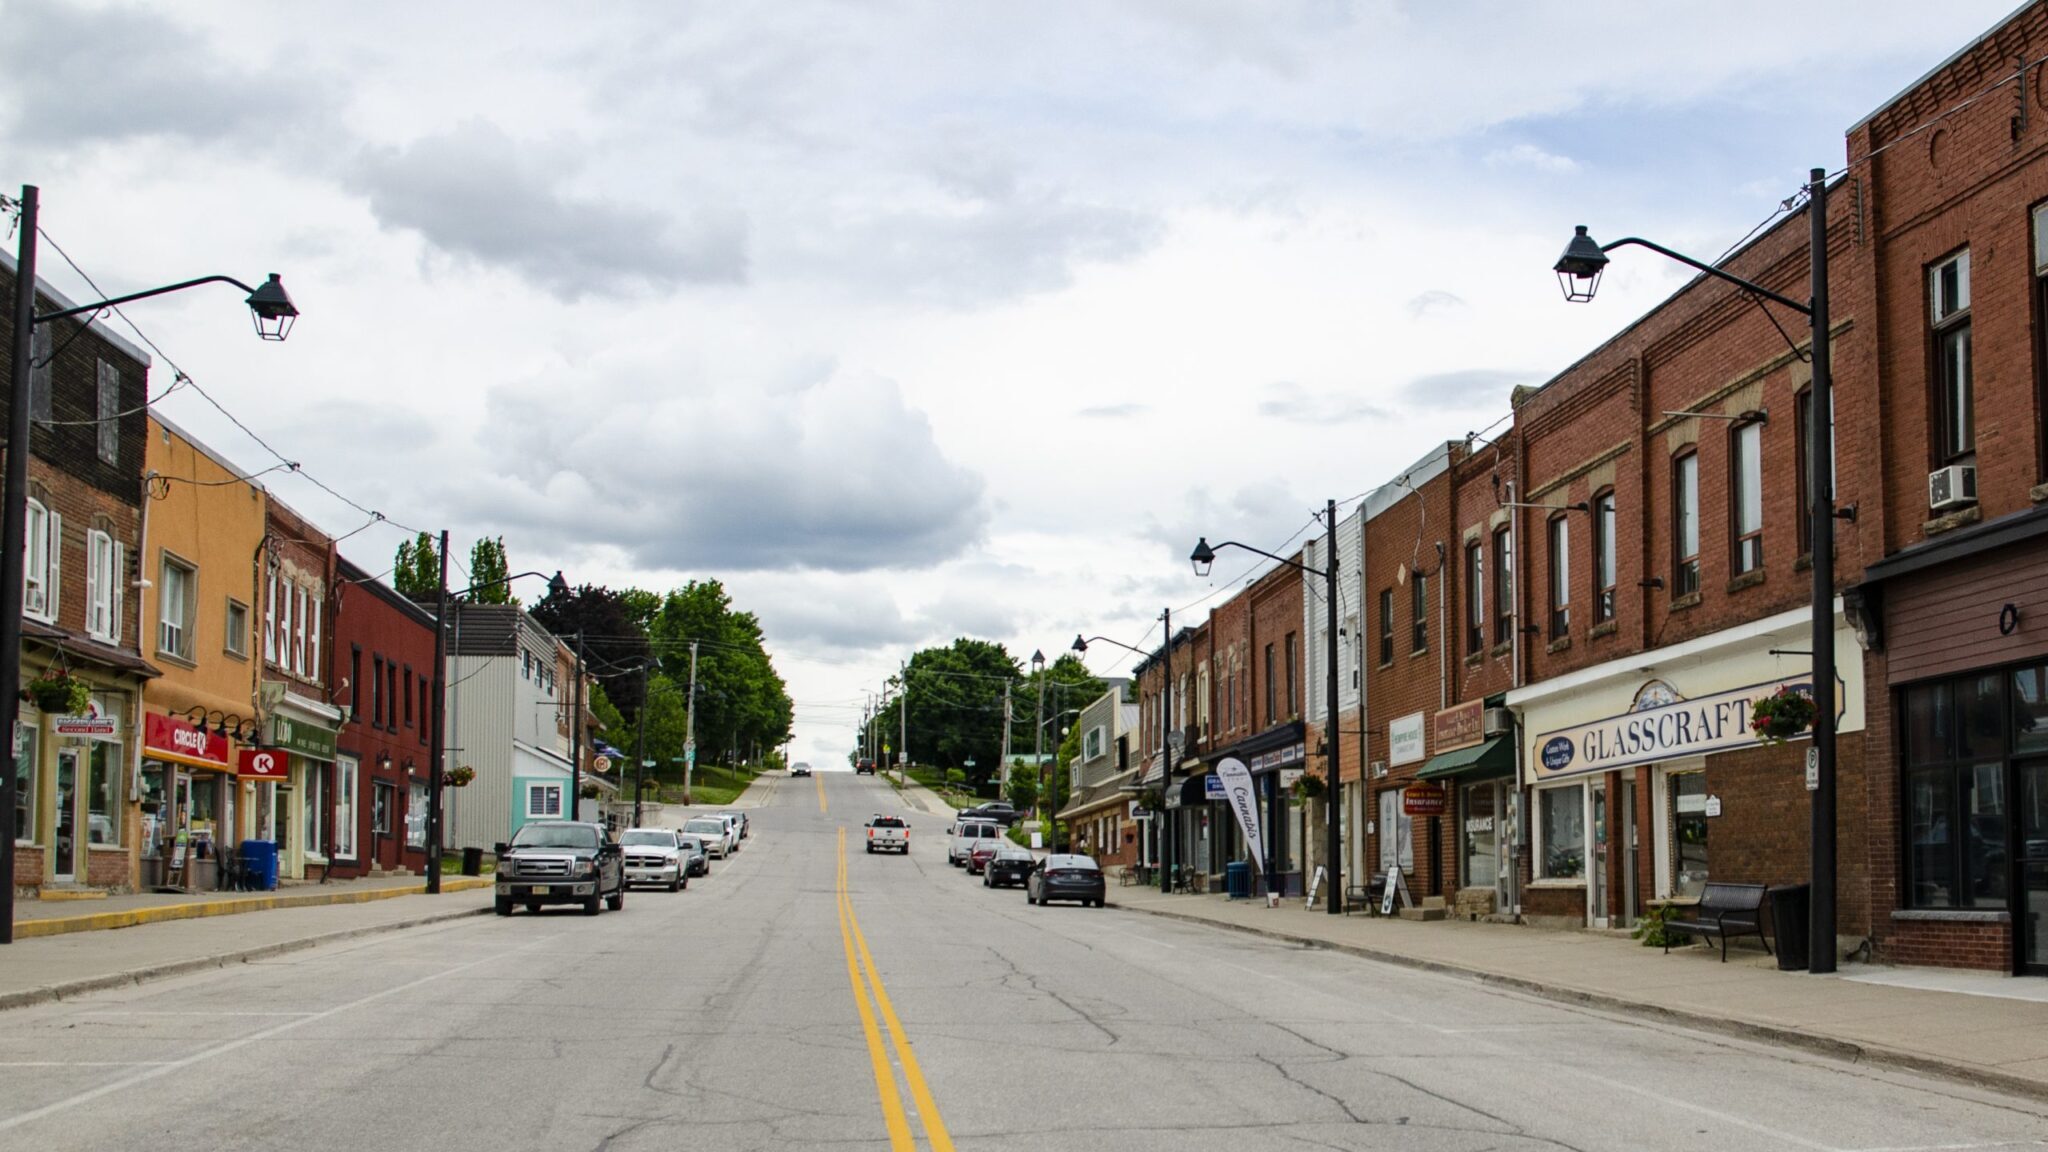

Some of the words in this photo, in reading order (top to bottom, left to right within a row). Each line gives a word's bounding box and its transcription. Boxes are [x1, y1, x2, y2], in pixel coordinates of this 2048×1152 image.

[174, 728, 197, 748] CIRCLE
[1583, 698, 1751, 763] GLASSCRAFT
[1233, 787, 1257, 839] Cannabis
[1406, 798, 1443, 806] Insurance
